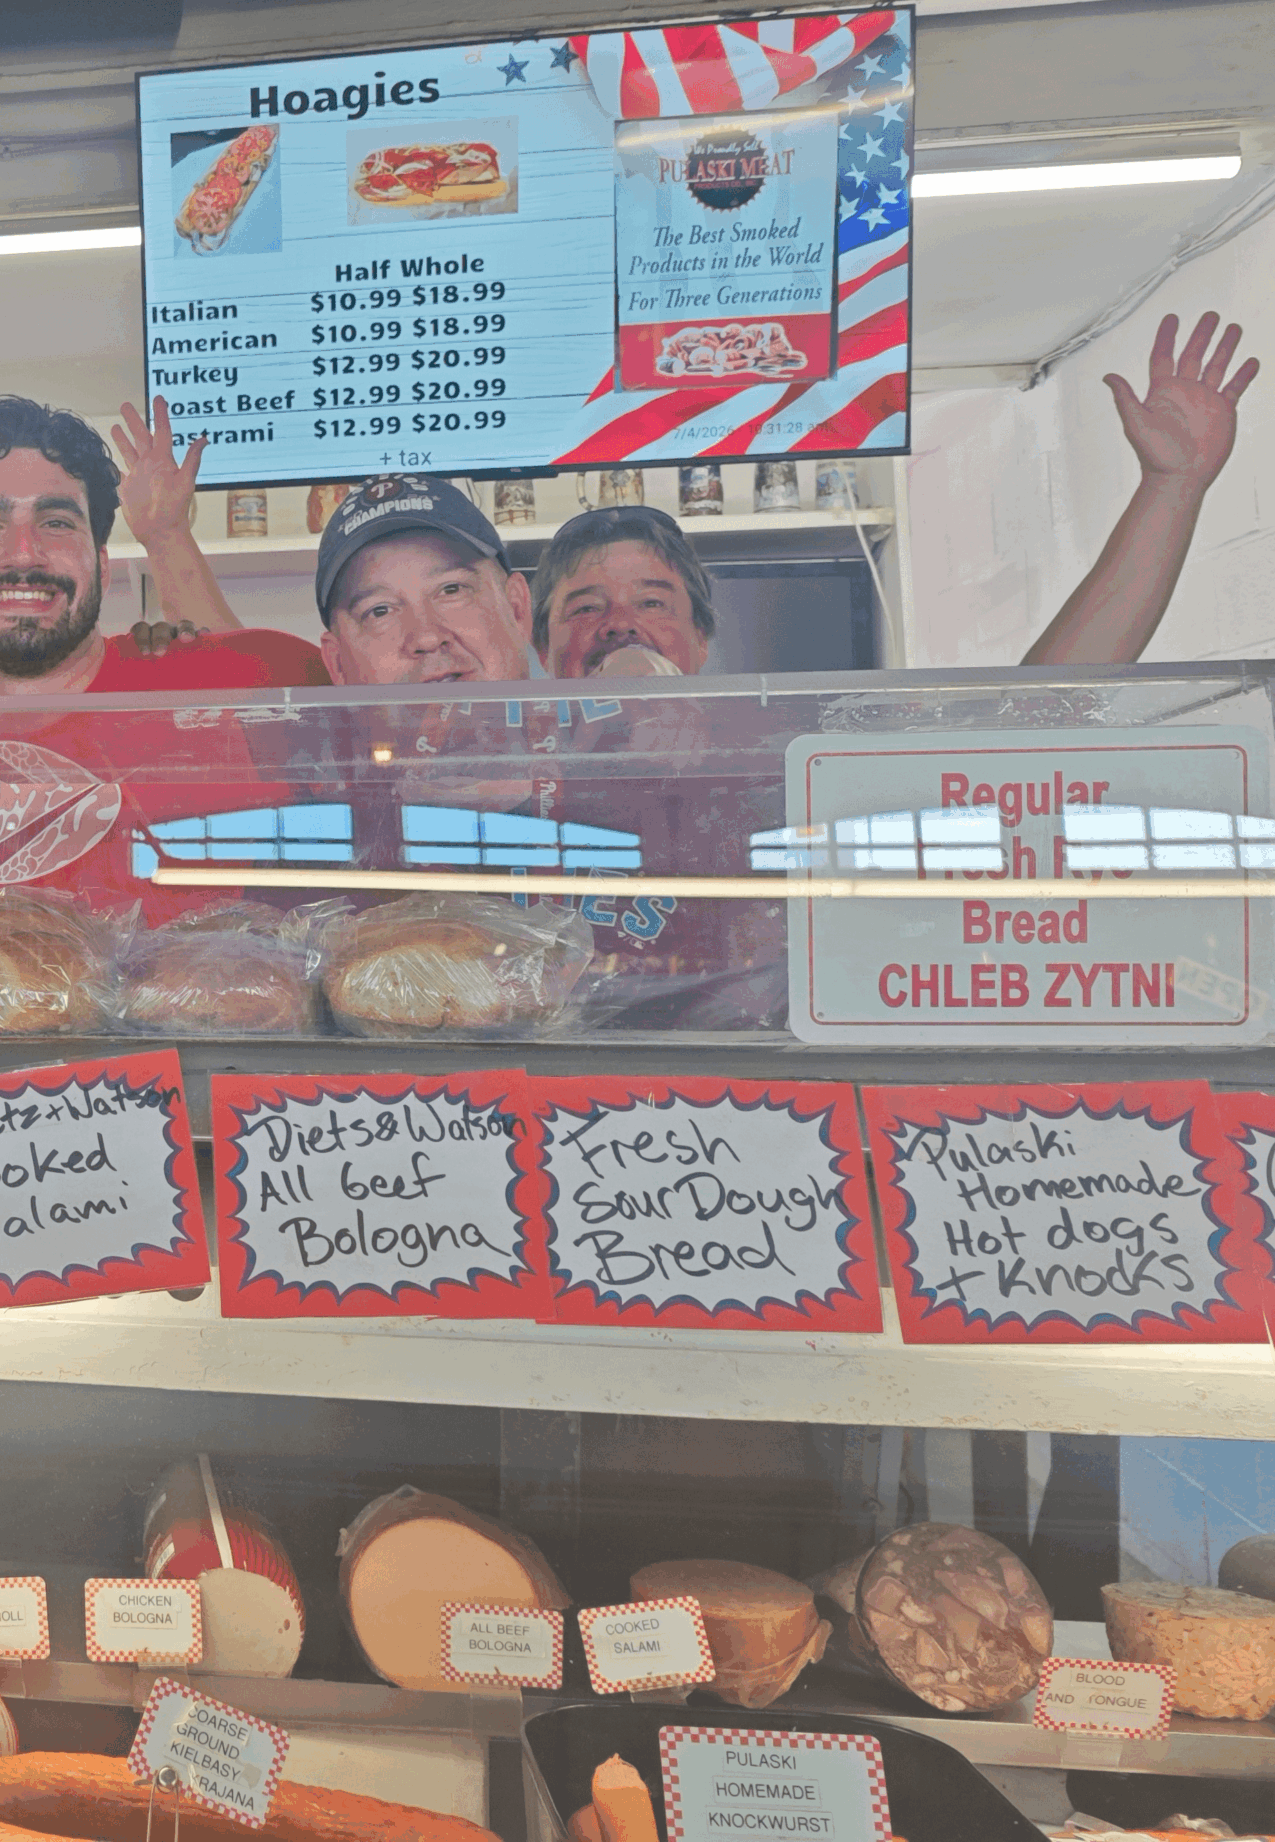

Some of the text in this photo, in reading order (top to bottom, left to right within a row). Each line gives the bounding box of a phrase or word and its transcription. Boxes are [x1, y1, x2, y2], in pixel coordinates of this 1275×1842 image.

[250, 71, 441, 121] Hoagies
[658, 148, 795, 184] PULASKI MEAT
[653, 217, 802, 248] The Best Smoked
[335, 253, 485, 284] Half Whole
[628, 243, 824, 276] Products in the World
[152, 280, 507, 324] Italian $10.99 $18.99
[627, 282, 822, 312] For Three Generations
[152, 313, 507, 355] American $10.99 $18.99
[152, 345, 507, 387] Turkey $12.99 $20.99
[236, 389, 296, 414] Beef
[313, 385, 402, 410] $12.99
[411, 377, 507, 404] $20.99
[172, 409, 507, 447] astrami $12.99 $20.99
[673, 424, 735, 441] 7/4/2026
[398, 447, 432, 466] tax
[345, 497, 433, 536] CHAMPIONS
[942, 771, 1110, 828] Regular
[964, 899, 1088, 944] Bread
[878, 962, 1175, 1008] CHLEB ZYTNI
[558, 1112, 742, 1180] Fresh
[904, 1122, 1077, 1181] Pulaski
[259, 1164, 312, 1212] All
[958, 1160, 1202, 1212] Homemade
[278, 1210, 513, 1268] Bologna
[943, 1206, 1179, 1257] Hot dogs
[575, 1220, 797, 1286] Bread
[936, 1266, 985, 1301] +
[112, 1611, 173, 1625] BOLOGNA
[118, 1595, 172, 1607] CHICKEN
[470, 1622, 530, 1636] ALL BEEF
[605, 1618, 660, 1635] COOKED
[469, 1639, 532, 1653] BOLOGNA
[614, 1640, 661, 1654] SALAMI
[1076, 1673, 1126, 1687] BLOOD
[1045, 1692, 1076, 1705] AND
[175, 1722, 241, 1761] GROUND
[188, 1706, 249, 1742] COARSE
[169, 1740, 242, 1782] KIELBASY
[725, 1750, 798, 1772] PULASKI
[715, 1782, 816, 1801] HOMEMADE
[708, 1812, 831, 1835] KNOCKWURST
